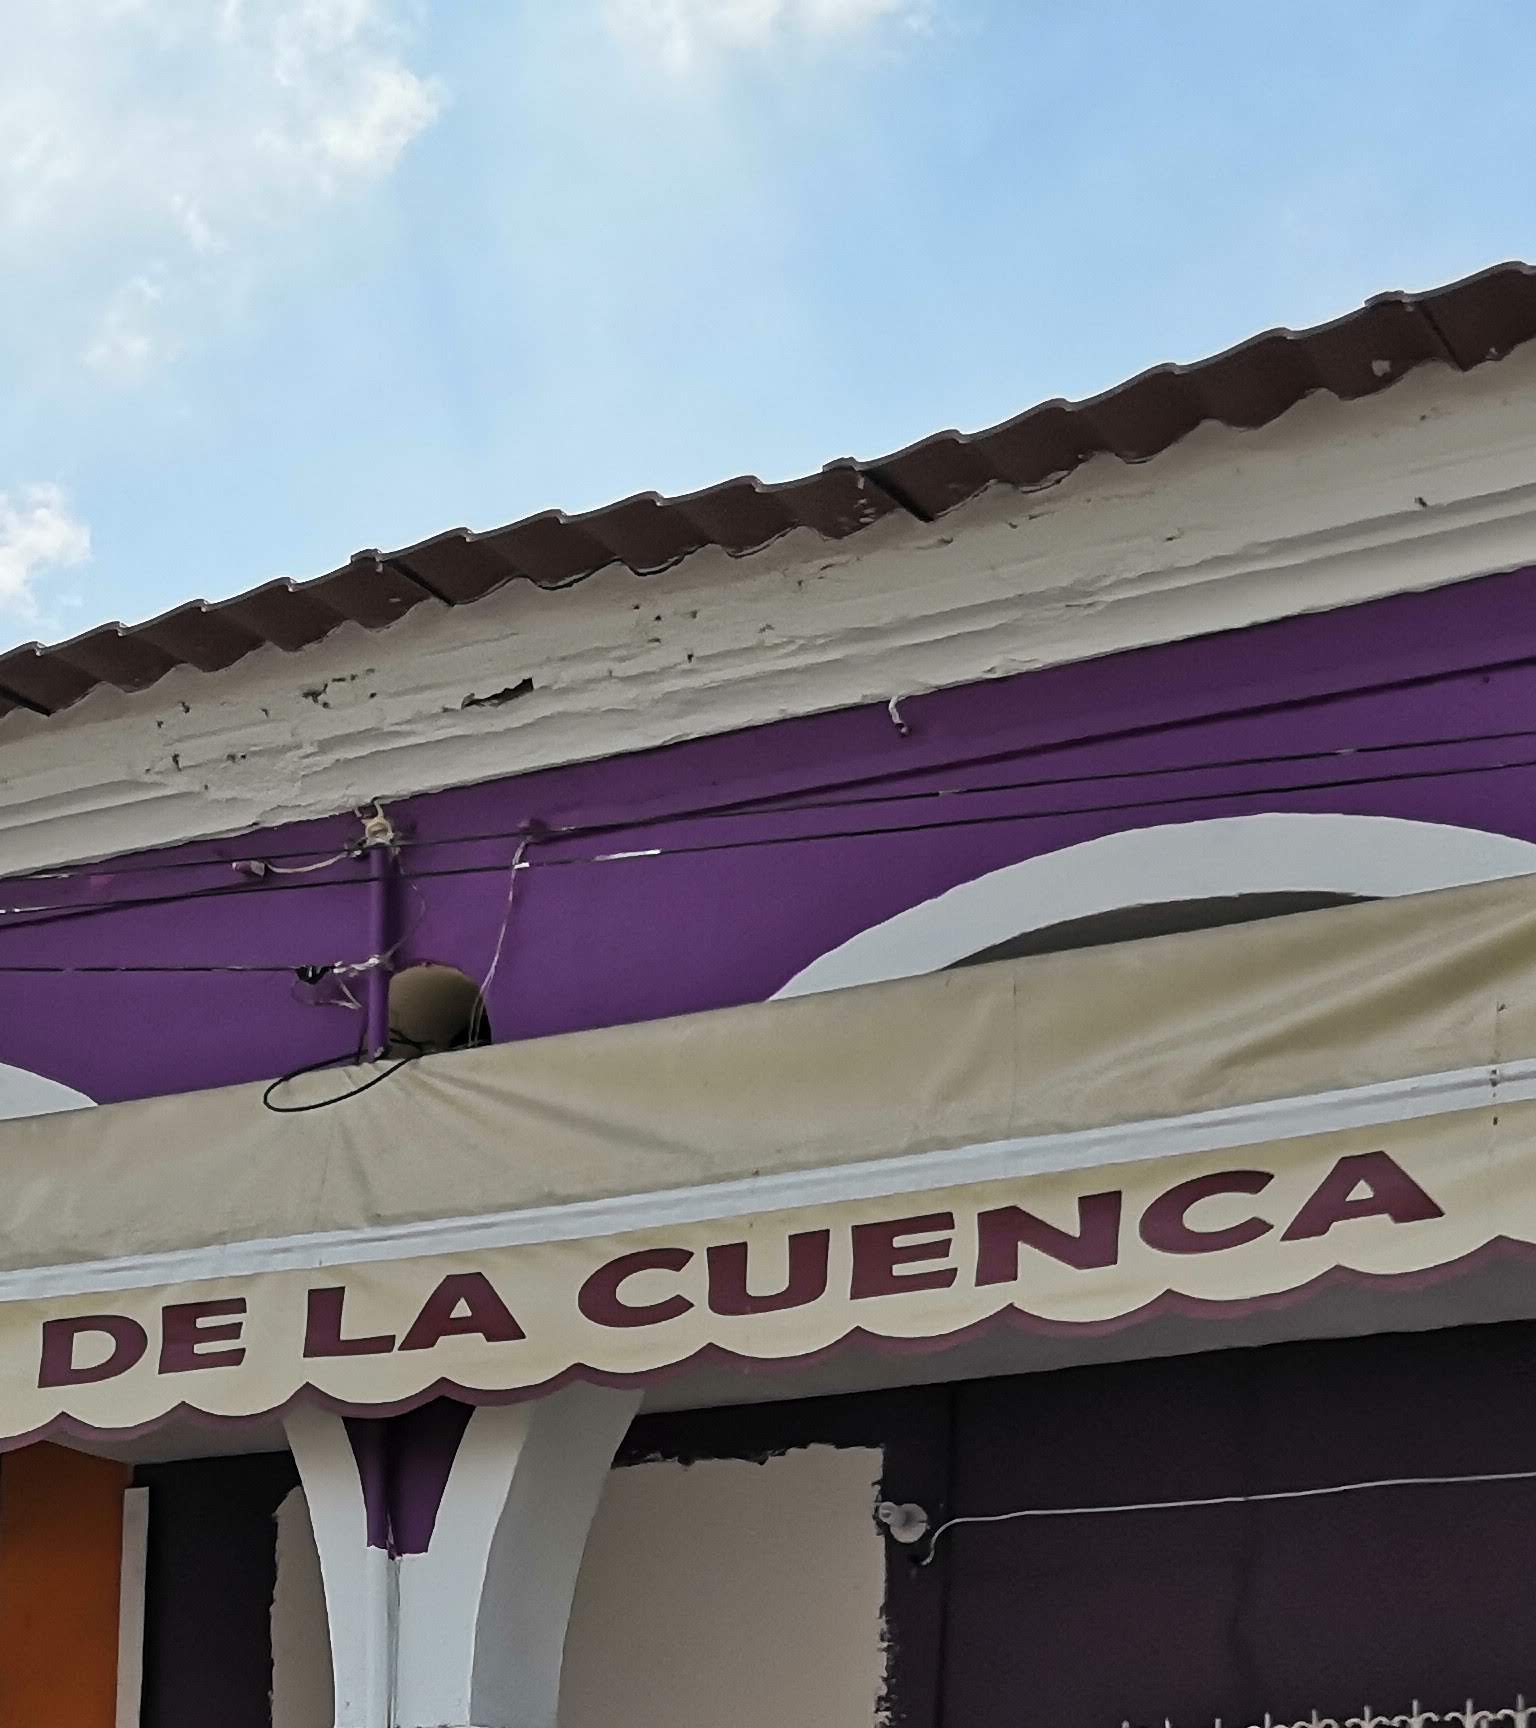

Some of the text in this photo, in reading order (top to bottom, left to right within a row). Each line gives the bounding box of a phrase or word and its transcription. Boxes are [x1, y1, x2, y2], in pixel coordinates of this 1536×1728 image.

[37, 1296, 247, 1389] DE
[302, 1271, 527, 1359] LA
[577, 1150, 1446, 1328] CUENCA
